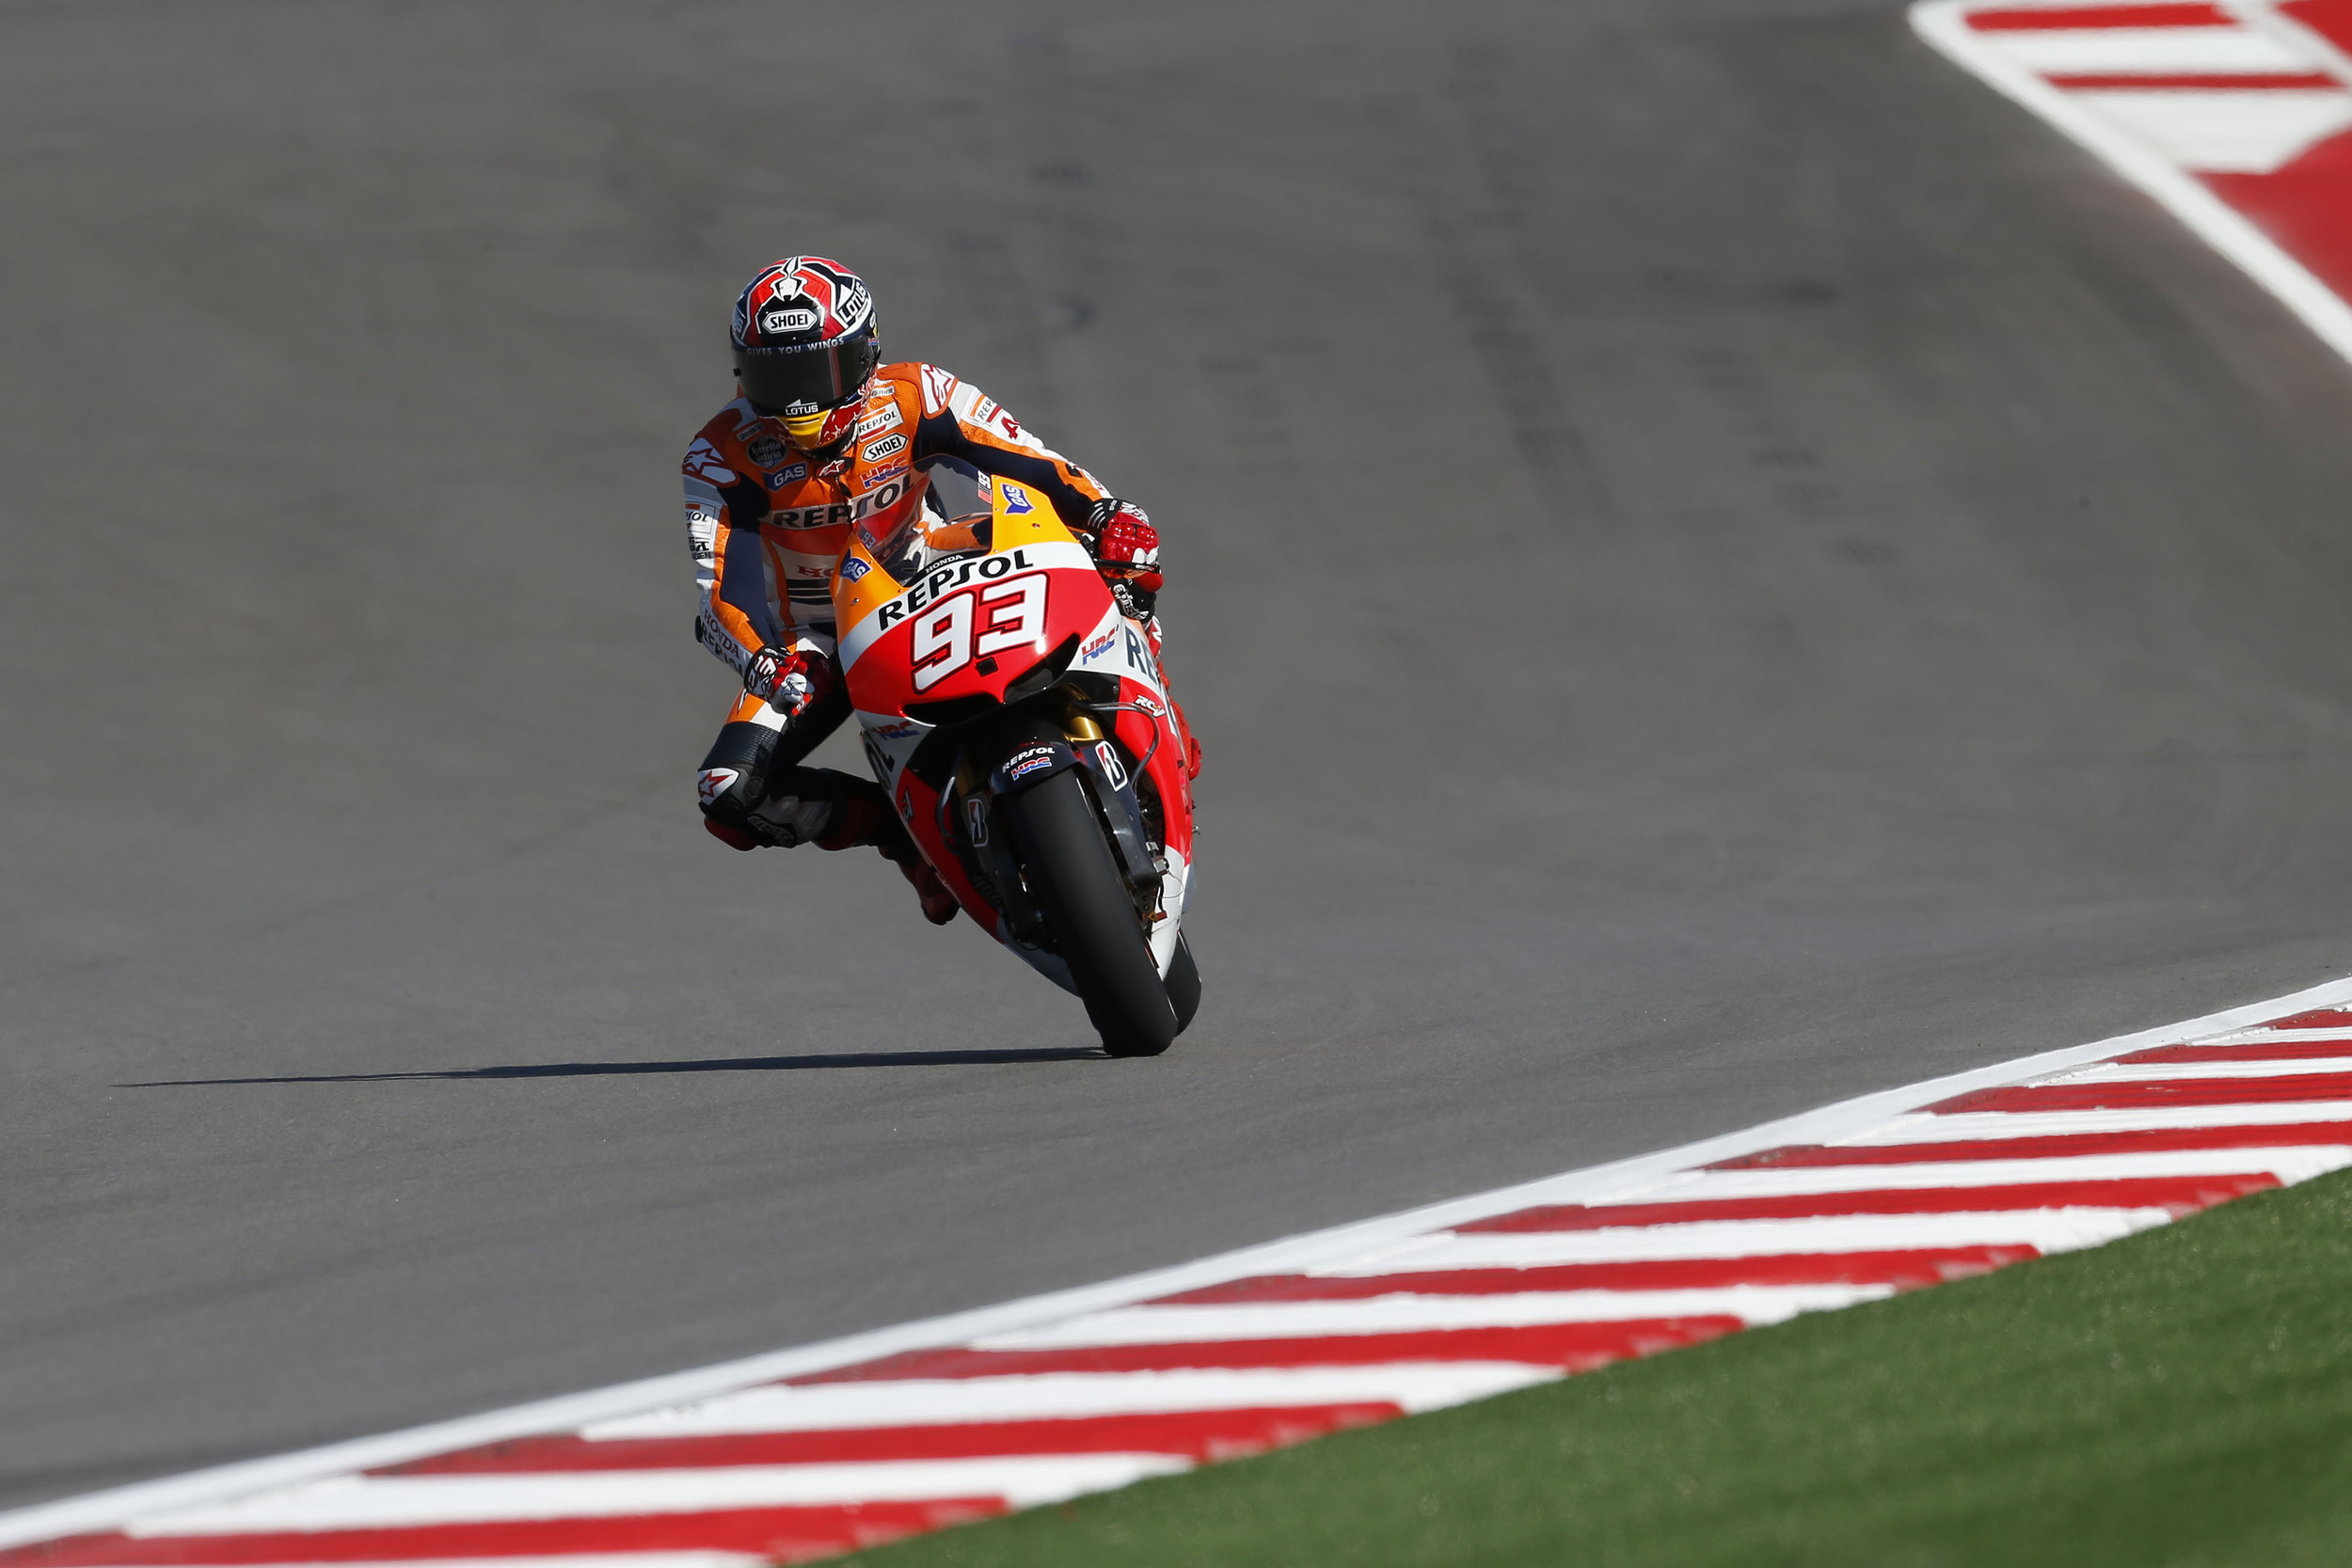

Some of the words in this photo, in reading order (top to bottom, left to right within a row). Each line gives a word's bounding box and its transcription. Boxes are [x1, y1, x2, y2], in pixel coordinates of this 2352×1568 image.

[839, 281, 866, 323] LOTUS
[770, 314, 808, 328] SHOEI
[779, 345, 802, 355] YOU
[807, 337, 845, 351] WINGS
[786, 404, 818, 416] LOTUS
[858, 410, 897, 434] REPSOL
[867, 436, 902, 459] SHOEI
[773, 466, 805, 486] GAS
[860, 455, 910, 488] HRC
[773, 475, 917, 528] REPSOL
[1005, 485, 1029, 507] GAS
[843, 561, 866, 579] GAS
[925, 554, 964, 574] HONDA
[878, 549, 1034, 632] REPSOL
[704, 608, 740, 658] HONDA
[911, 571, 1051, 695] 93
[1082, 626, 1116, 666] HRC
[796, 700, 806, 711] 93
[1002, 747, 1056, 774] REPSOL
[1010, 756, 1053, 781] HRC
